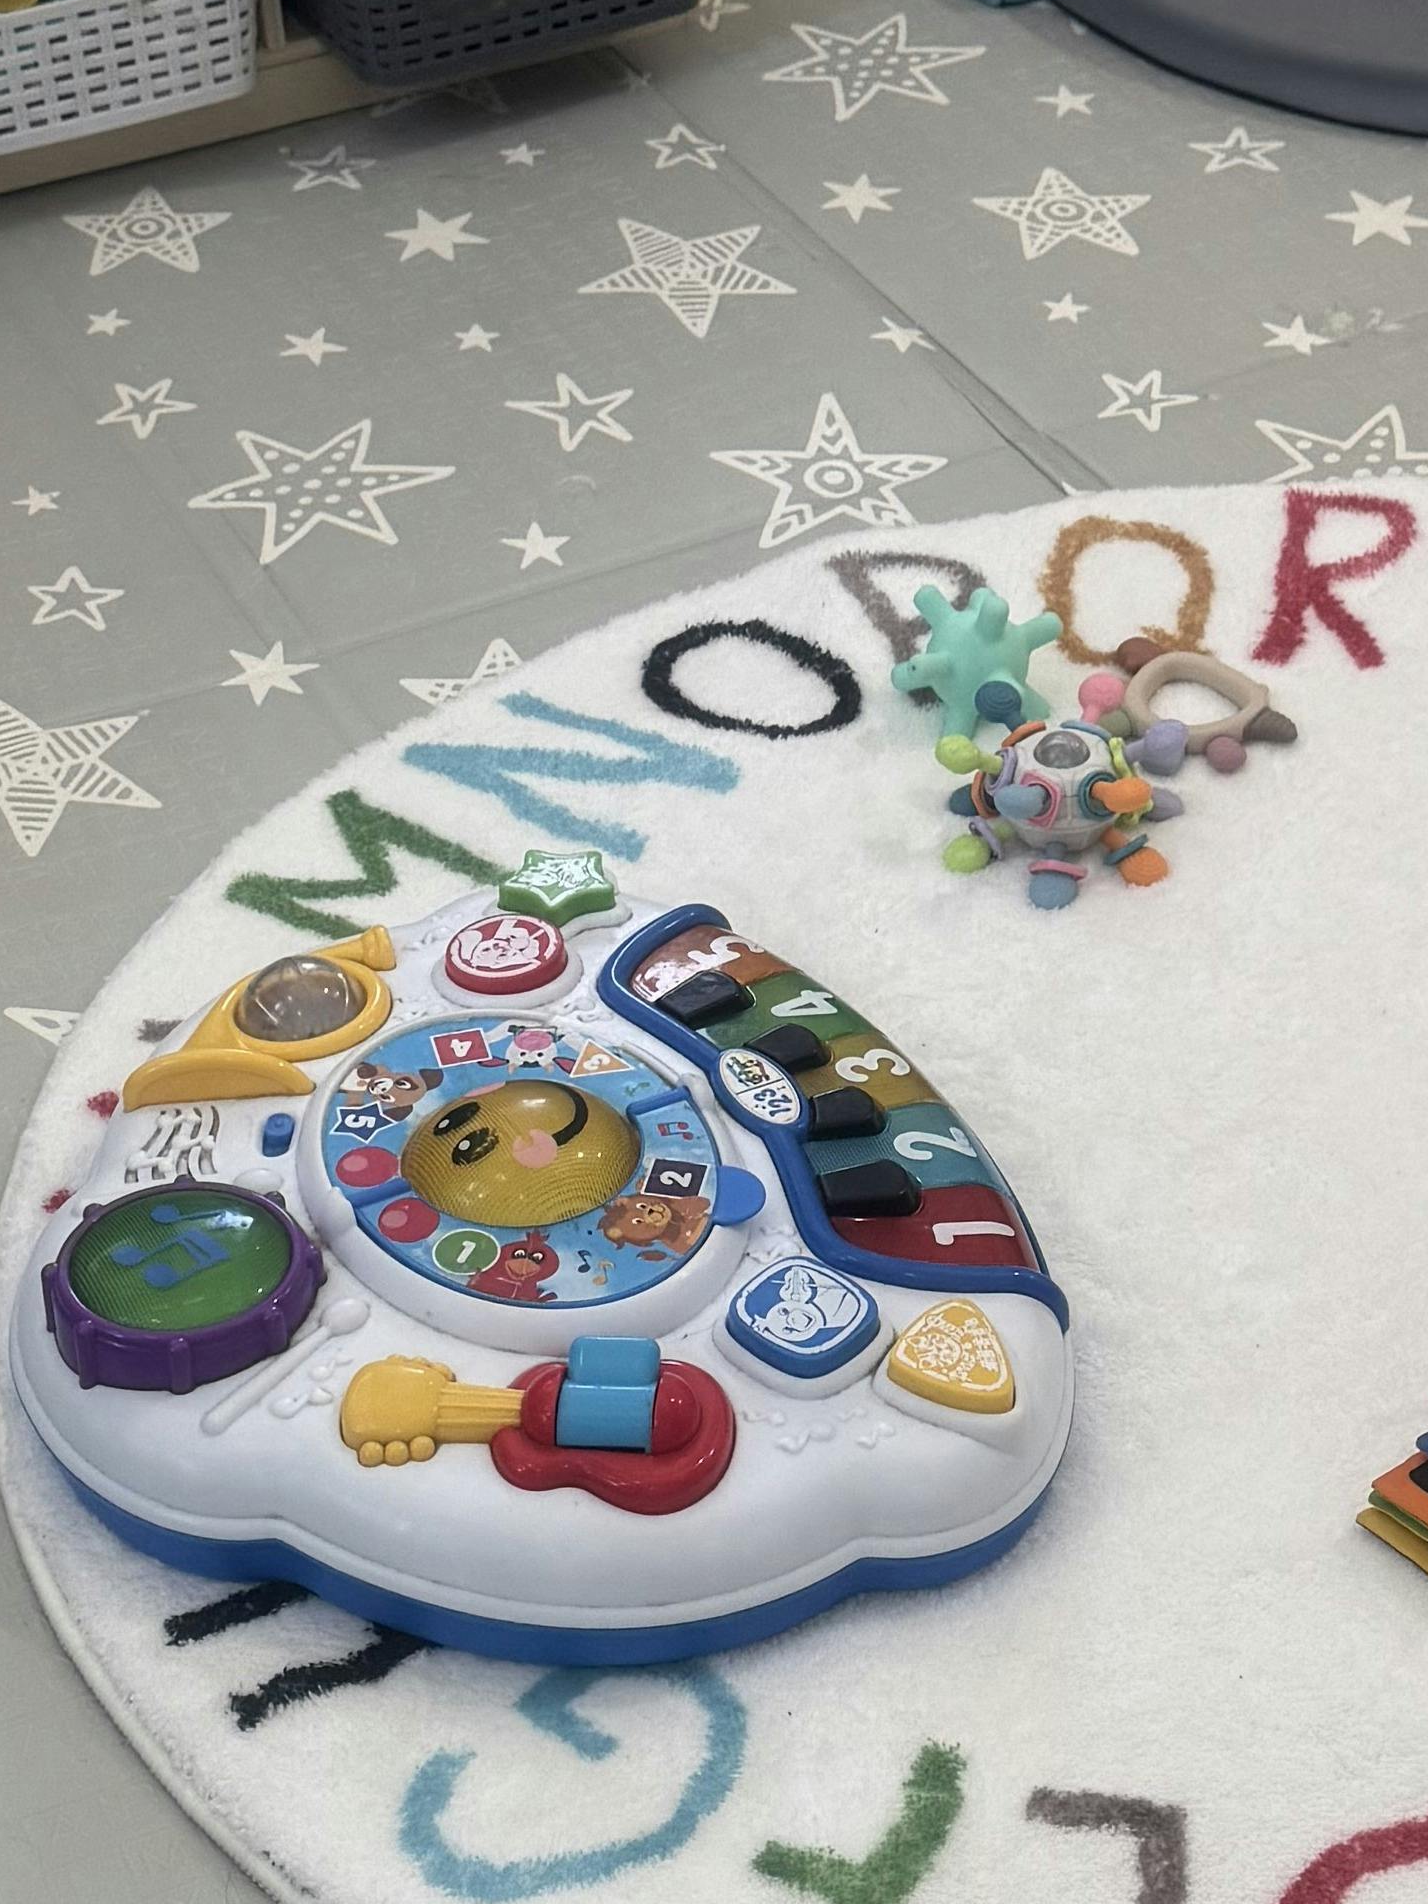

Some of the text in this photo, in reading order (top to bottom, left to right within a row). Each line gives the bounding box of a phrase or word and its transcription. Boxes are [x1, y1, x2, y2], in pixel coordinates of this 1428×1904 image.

[402, 688, 741, 861] N
[640, 617, 862, 738] O
[1251, 487, 1417, 670] R
[771, 989, 839, 1018] 4
[450, 1037, 473, 1057] 4
[835, 1048, 911, 1083] 3
[345, 1113, 376, 1130] 5
[893, 1127, 978, 1161] 2
[664, 1170, 693, 1187] 2
[931, 1220, 1015, 1246] 1
[456, 1240, 478, 1264] 1
